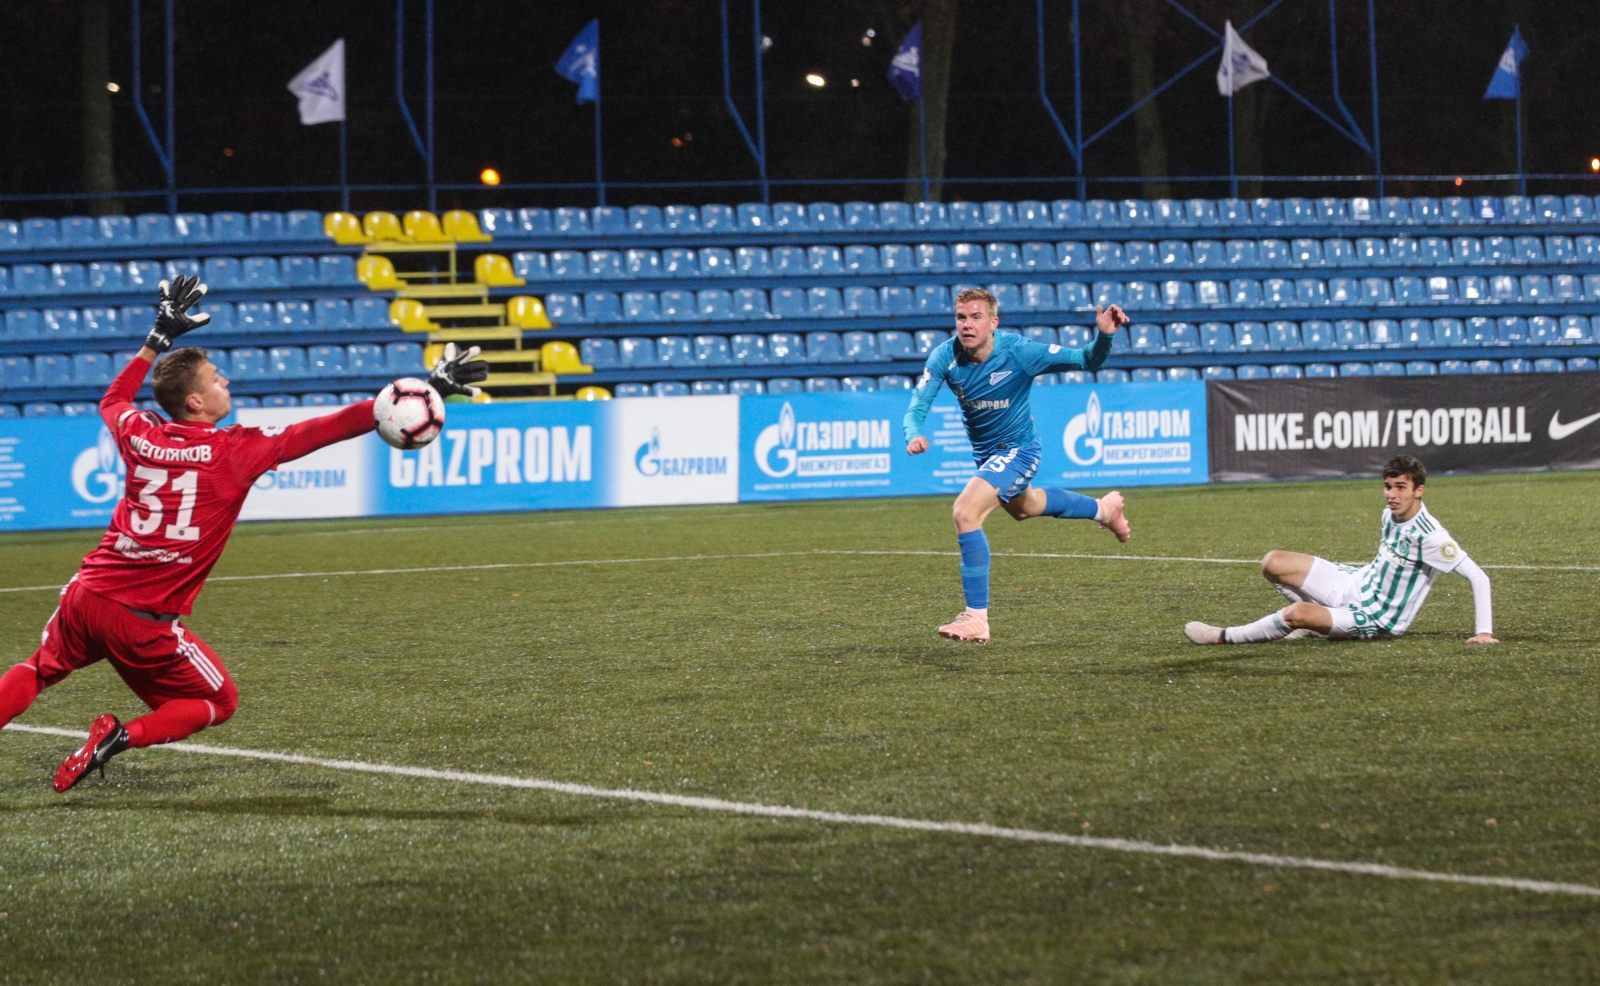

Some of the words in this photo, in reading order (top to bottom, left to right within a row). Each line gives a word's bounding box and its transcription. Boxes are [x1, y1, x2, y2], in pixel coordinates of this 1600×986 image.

[797, 419, 891, 451] ГАЗПРОМ
[1103, 409, 1191, 440] ГАЗПРОМ
[1235, 406, 1532, 451] NIKE.COM/FOOTBALL
[389, 425, 593, 488] GAZPROM
[663, 456, 727, 476] GAZPROM
[800, 457, 888, 472] МЕЖРЕГИОНГАЗ
[1105, 446, 1188, 460] МЕЖРЕГИОНГАЗ
[278, 469, 346, 489] GAZPROM
[132, 464, 200, 541] 31
